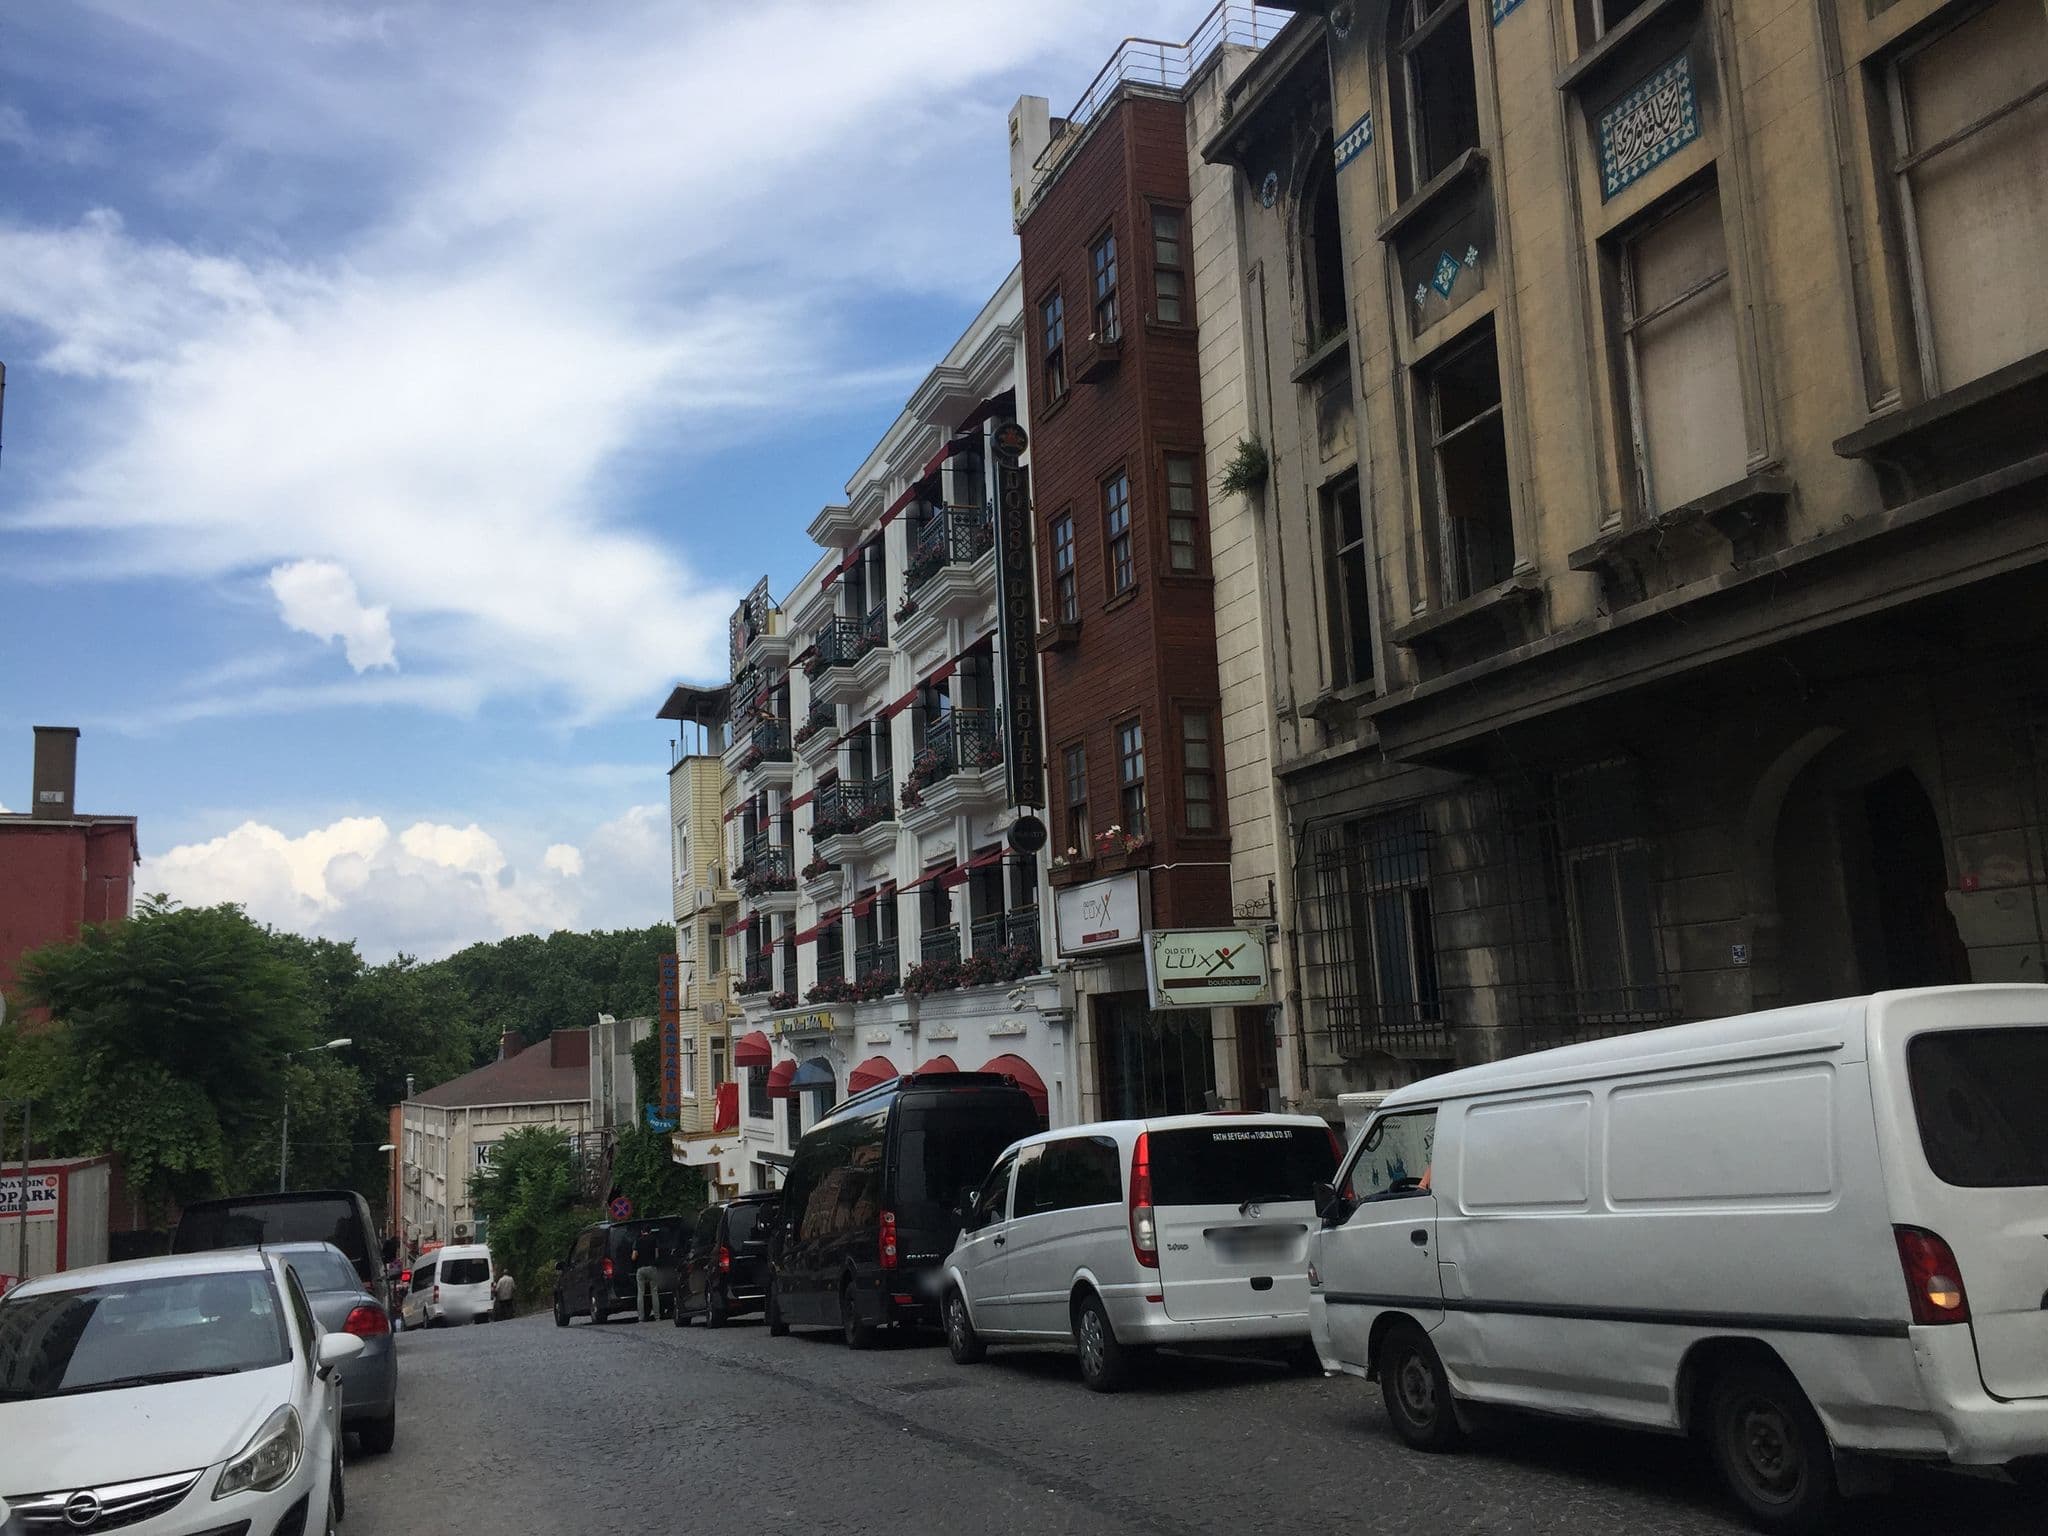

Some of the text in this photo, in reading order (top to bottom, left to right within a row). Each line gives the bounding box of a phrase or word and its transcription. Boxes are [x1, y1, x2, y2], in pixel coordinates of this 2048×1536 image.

[1016, 695, 1035, 800] HOTELS
[663, 959, 676, 1012] HOTEL
[650, 1118, 672, 1128] HOTEL
